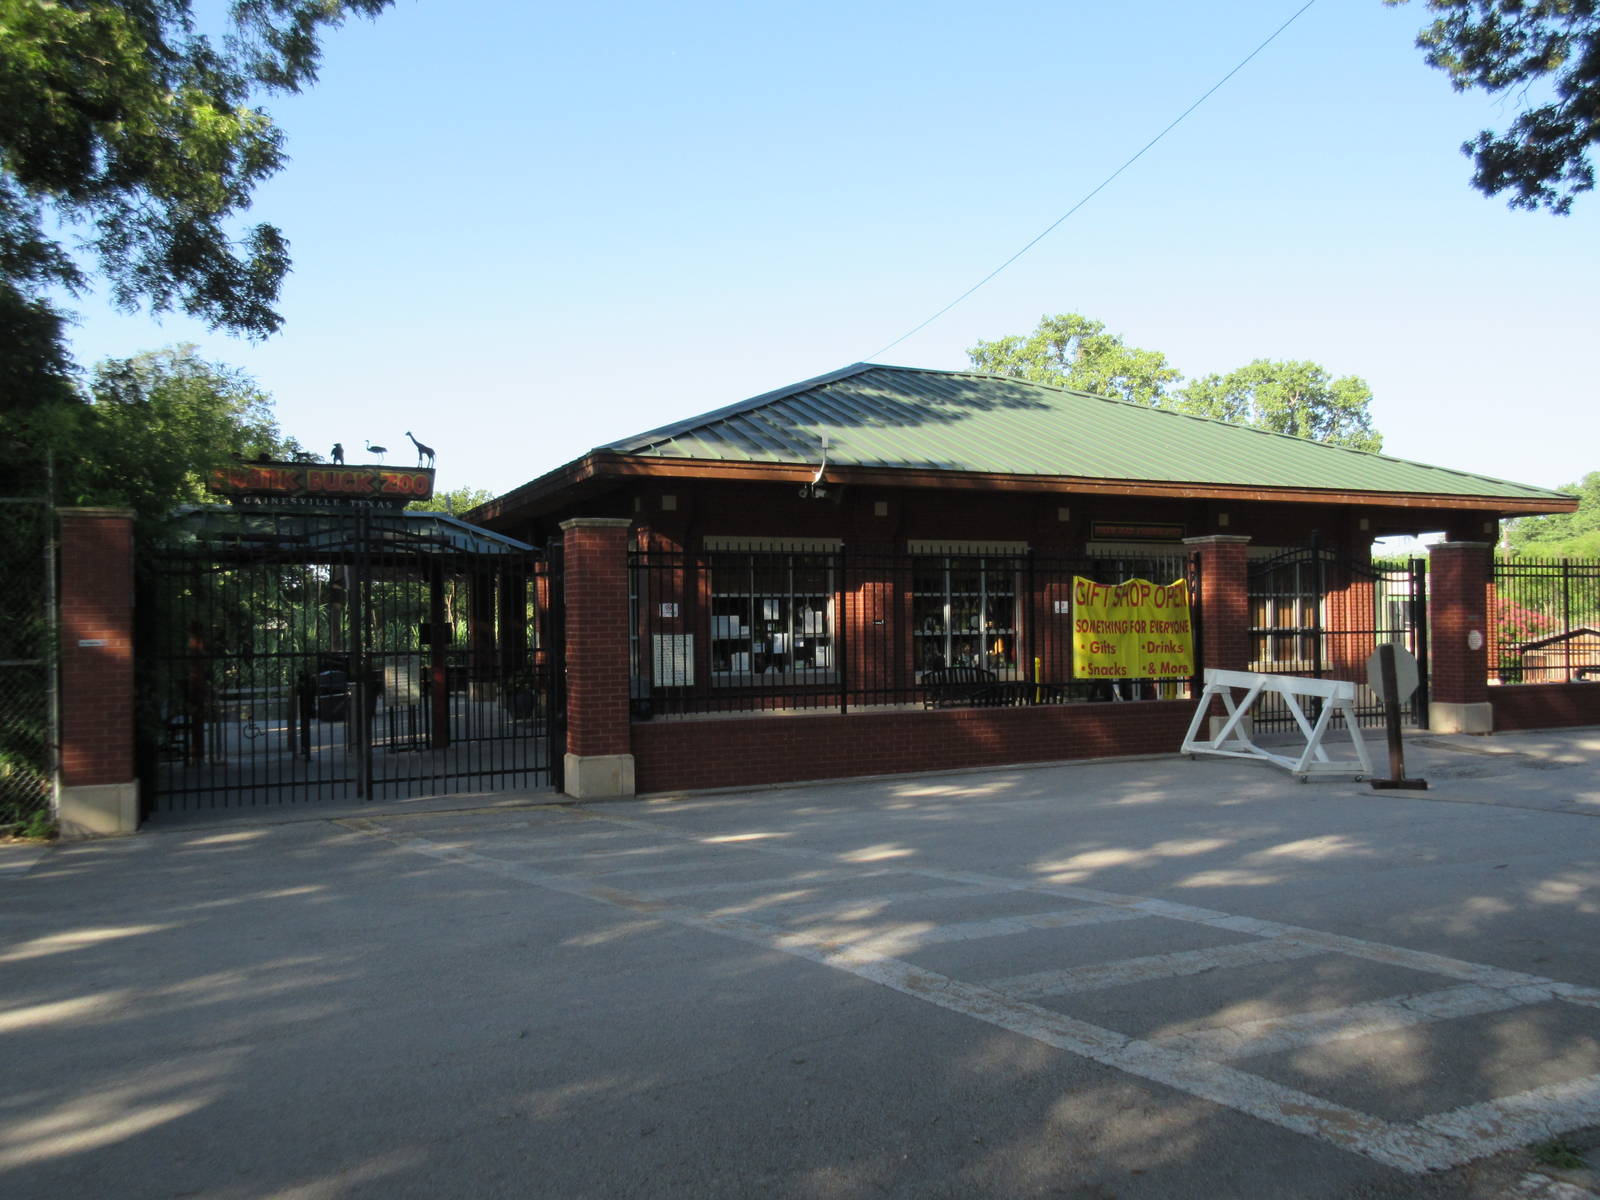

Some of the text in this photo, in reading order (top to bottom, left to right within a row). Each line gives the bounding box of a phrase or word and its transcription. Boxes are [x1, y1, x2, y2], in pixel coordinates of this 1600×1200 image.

[307, 470, 374, 493] BUCK
[381, 472, 430, 495] ZOO
[351, 500, 393, 509] TEXAS
[1076, 581, 1112, 607] GIFT
[1113, 583, 1151, 608] SHOP
[1154, 583, 1187, 608] OPEN
[1075, 619, 1189, 634] SOMETHING FOR EVERYONE
[1090, 640, 1116, 654] Gifts
[1147, 640, 1184, 653] Drinks
[1088, 662, 1127, 676] Snacks
[1148, 662, 1189, 675] & More
